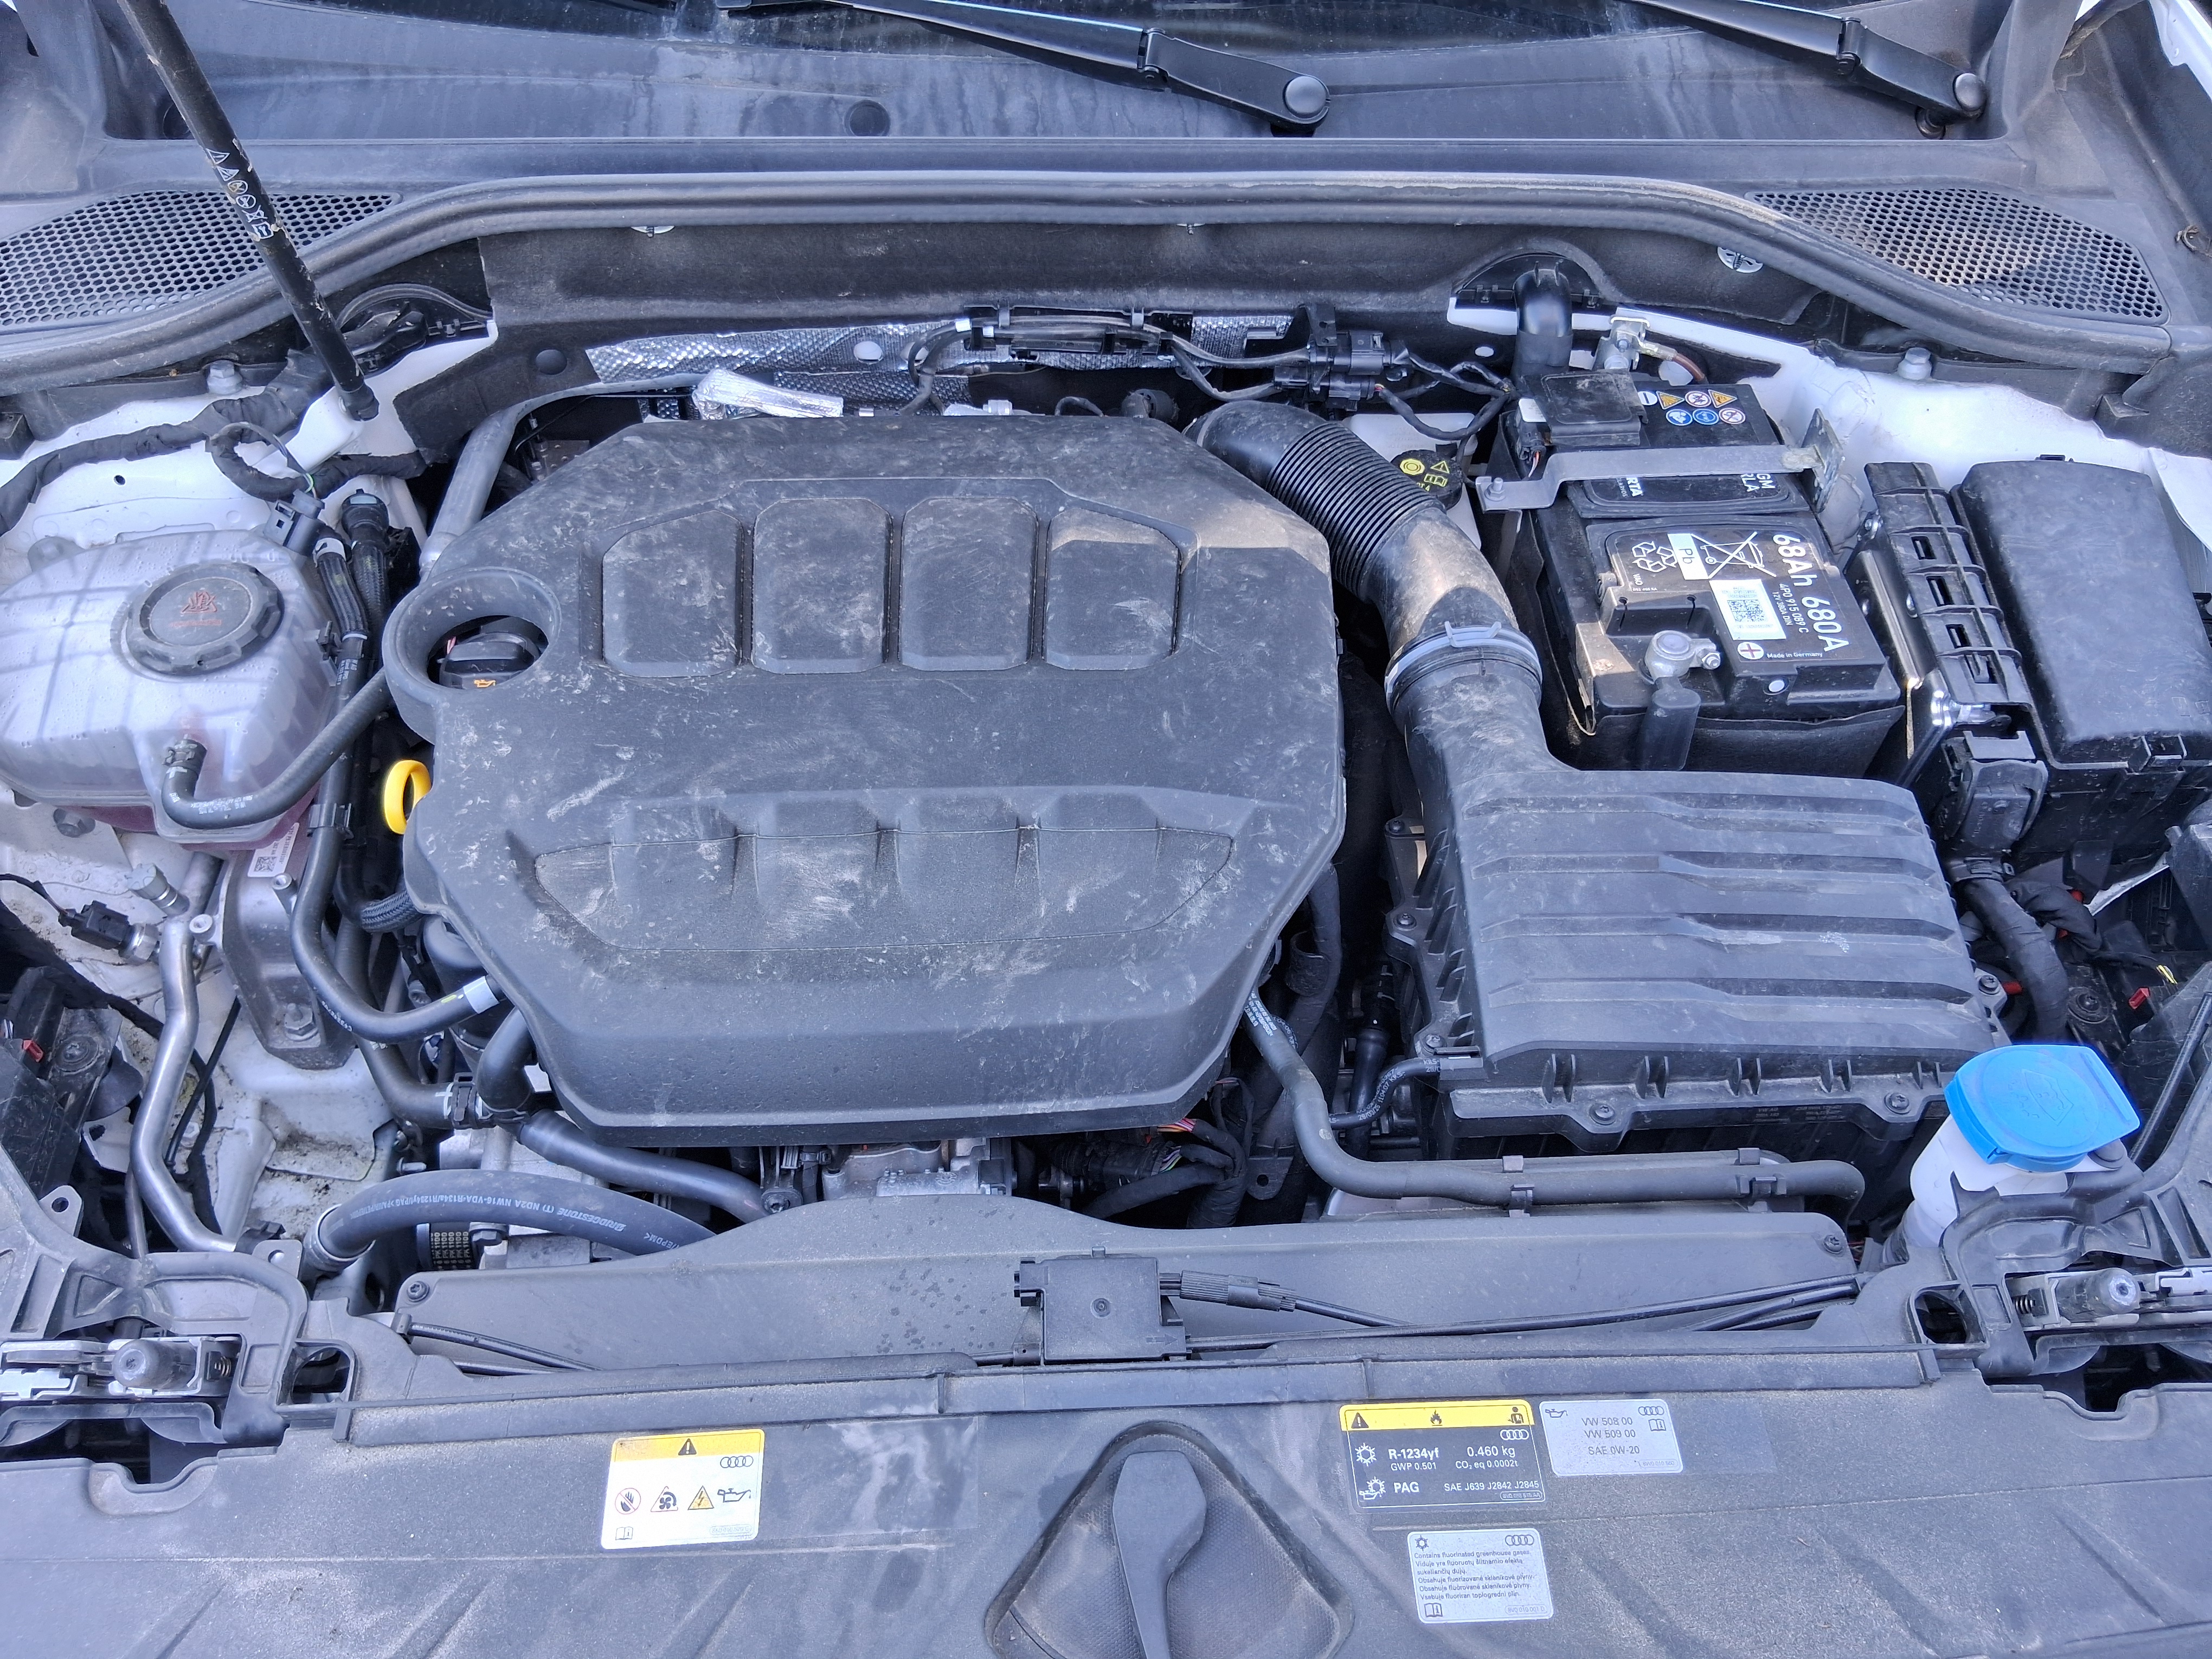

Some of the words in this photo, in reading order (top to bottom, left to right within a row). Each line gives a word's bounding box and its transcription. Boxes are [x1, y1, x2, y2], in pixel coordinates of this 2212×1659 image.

[1616, 478, 1628, 497] LARIOS
[1626, 477, 1643, 497] RTA
[1740, 474, 1760, 492] RLA
[1757, 474, 1776, 488] GM
[1679, 548, 1695, 564] Pb
[1773, 534, 1818, 586] 68Ah
[1802, 596, 1849, 652] 680A
[1772, 591, 1781, 600] 12V
[1783, 615, 1793, 626] DIN
[1785, 599, 1800, 612] 915
[1792, 613, 1806, 626] 089
[515, 1199, 540, 1211] ND2A
[542, 1205, 554, 1214] (T)
[557, 1207, 626, 1232] BRIDGESTONE
[1581, 1418, 1598, 1426] VW
[1602, 1417, 1619, 1425] 508
[1584, 1430, 1601, 1438] VW
[1605, 1430, 1622, 1438] 509
[1624, 1429, 1636, 1437] 00
[1388, 1447, 1439, 1460] R-1234yf
[1467, 1446, 1499, 1457] 0.460
[1502, 1445, 1515, 1458] kg
[1588, 1446, 1607, 1455] SAE
[1611, 1445, 1640, 1454] 0W-20
[1391, 1463, 1412, 1471] GWP
[1414, 1462, 1437, 1470] 0.501
[1474, 1461, 1485, 1470] eq
[1487, 1459, 1519, 1468] 0.0002t
[1394, 1482, 1419, 1493] PAG
[1444, 1483, 1462, 1491] SAE
[1465, 1482, 1485, 1491] J639
[1487, 1481, 1512, 1490] J2842
[1515, 1480, 1539, 1489] J2845
